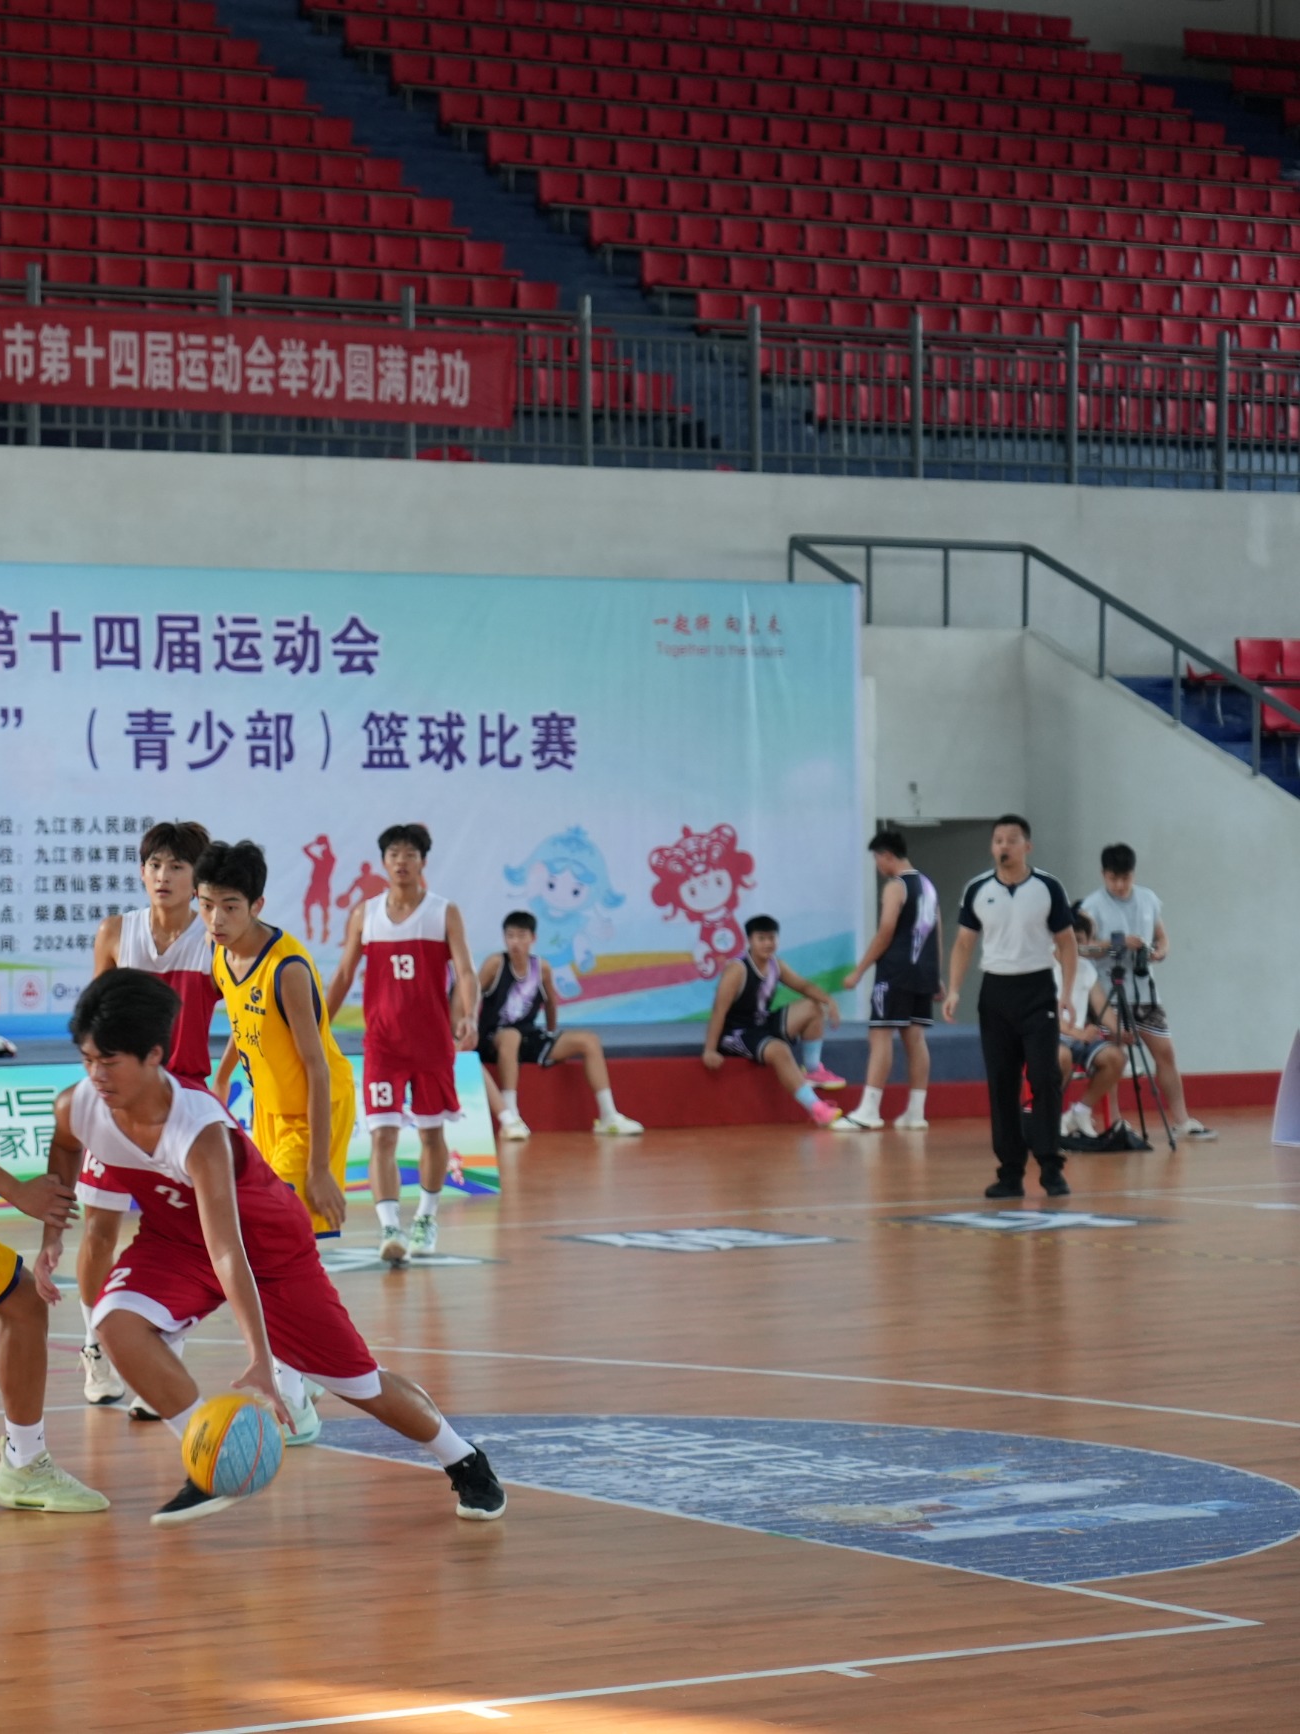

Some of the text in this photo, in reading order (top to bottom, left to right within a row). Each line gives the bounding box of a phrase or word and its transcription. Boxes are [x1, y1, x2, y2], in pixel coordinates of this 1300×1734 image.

[34, 875, 147, 894] 江西仙客来生
[390, 954, 415, 980] 13
[369, 1082, 394, 1108] 13
[155, 1185, 190, 1209] 2
[104, 1267, 132, 1293] 2
